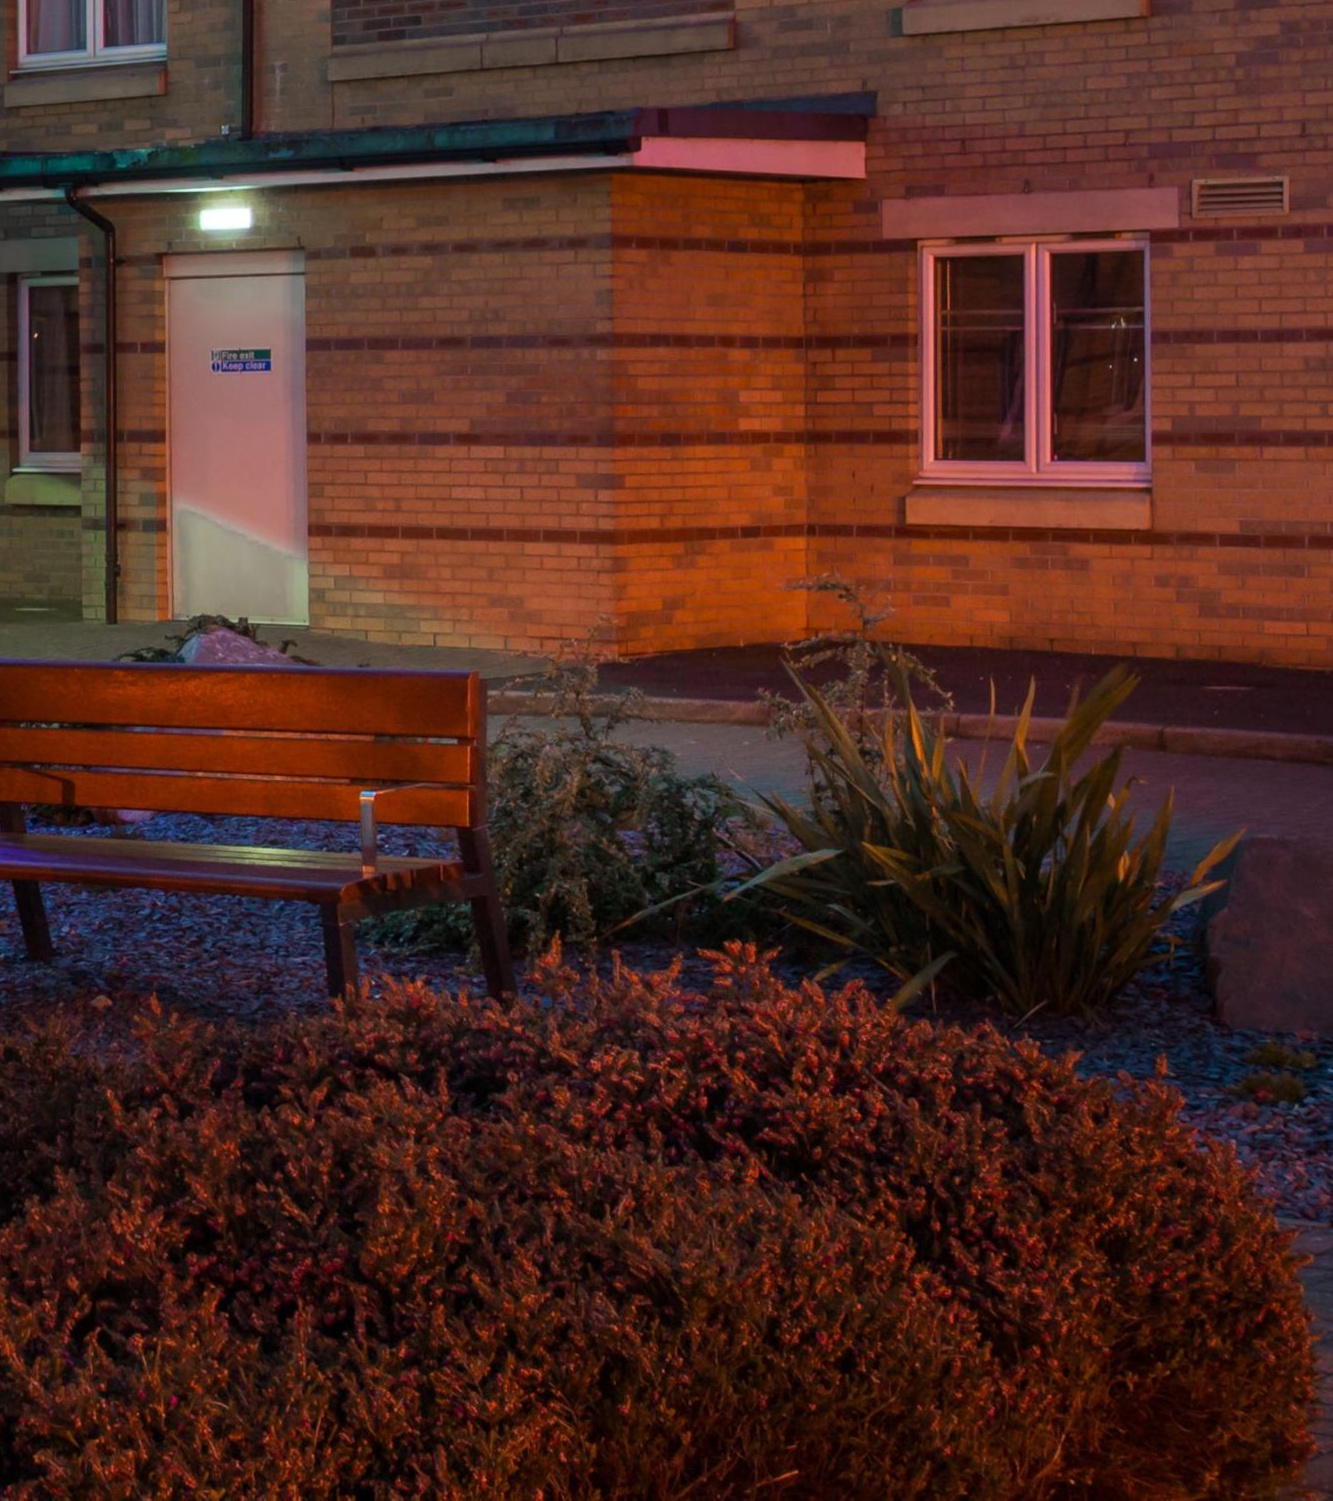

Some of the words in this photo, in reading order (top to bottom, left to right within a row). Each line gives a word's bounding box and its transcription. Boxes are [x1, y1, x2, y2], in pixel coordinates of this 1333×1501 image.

[221, 351, 238, 360] Fire
[239, 351, 255, 360] exit
[222, 362, 244, 371] Keep
[245, 361, 266, 370] clear
